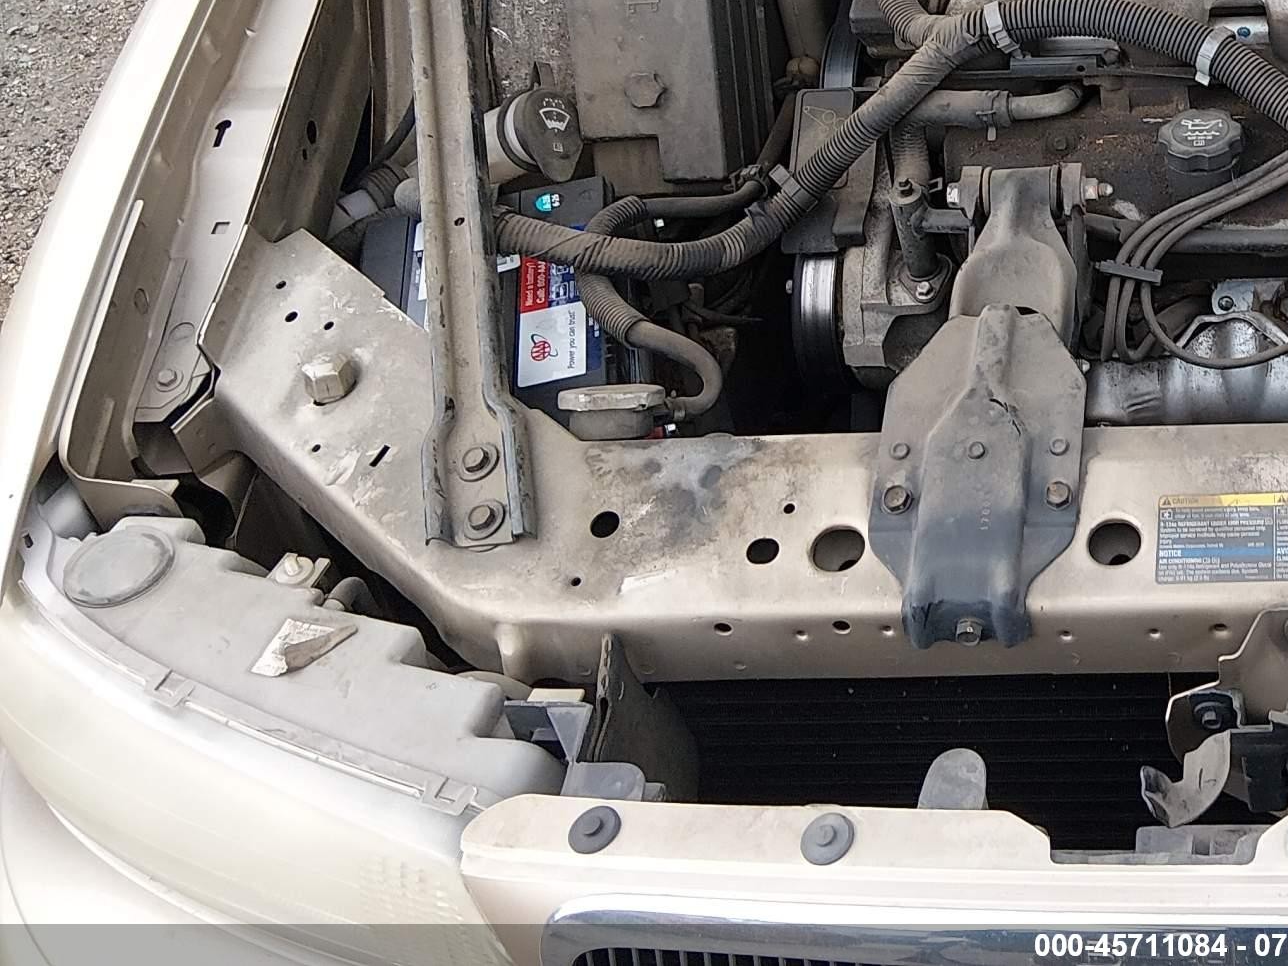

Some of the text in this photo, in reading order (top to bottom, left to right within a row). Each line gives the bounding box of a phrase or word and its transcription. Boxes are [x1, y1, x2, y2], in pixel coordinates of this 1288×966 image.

[568, 326, 576, 337] can
[568, 337, 577, 348] you
[568, 351, 576, 369] Power
[1172, 497, 1199, 505] CAUTION
[1159, 549, 1182, 557] NOTICE
